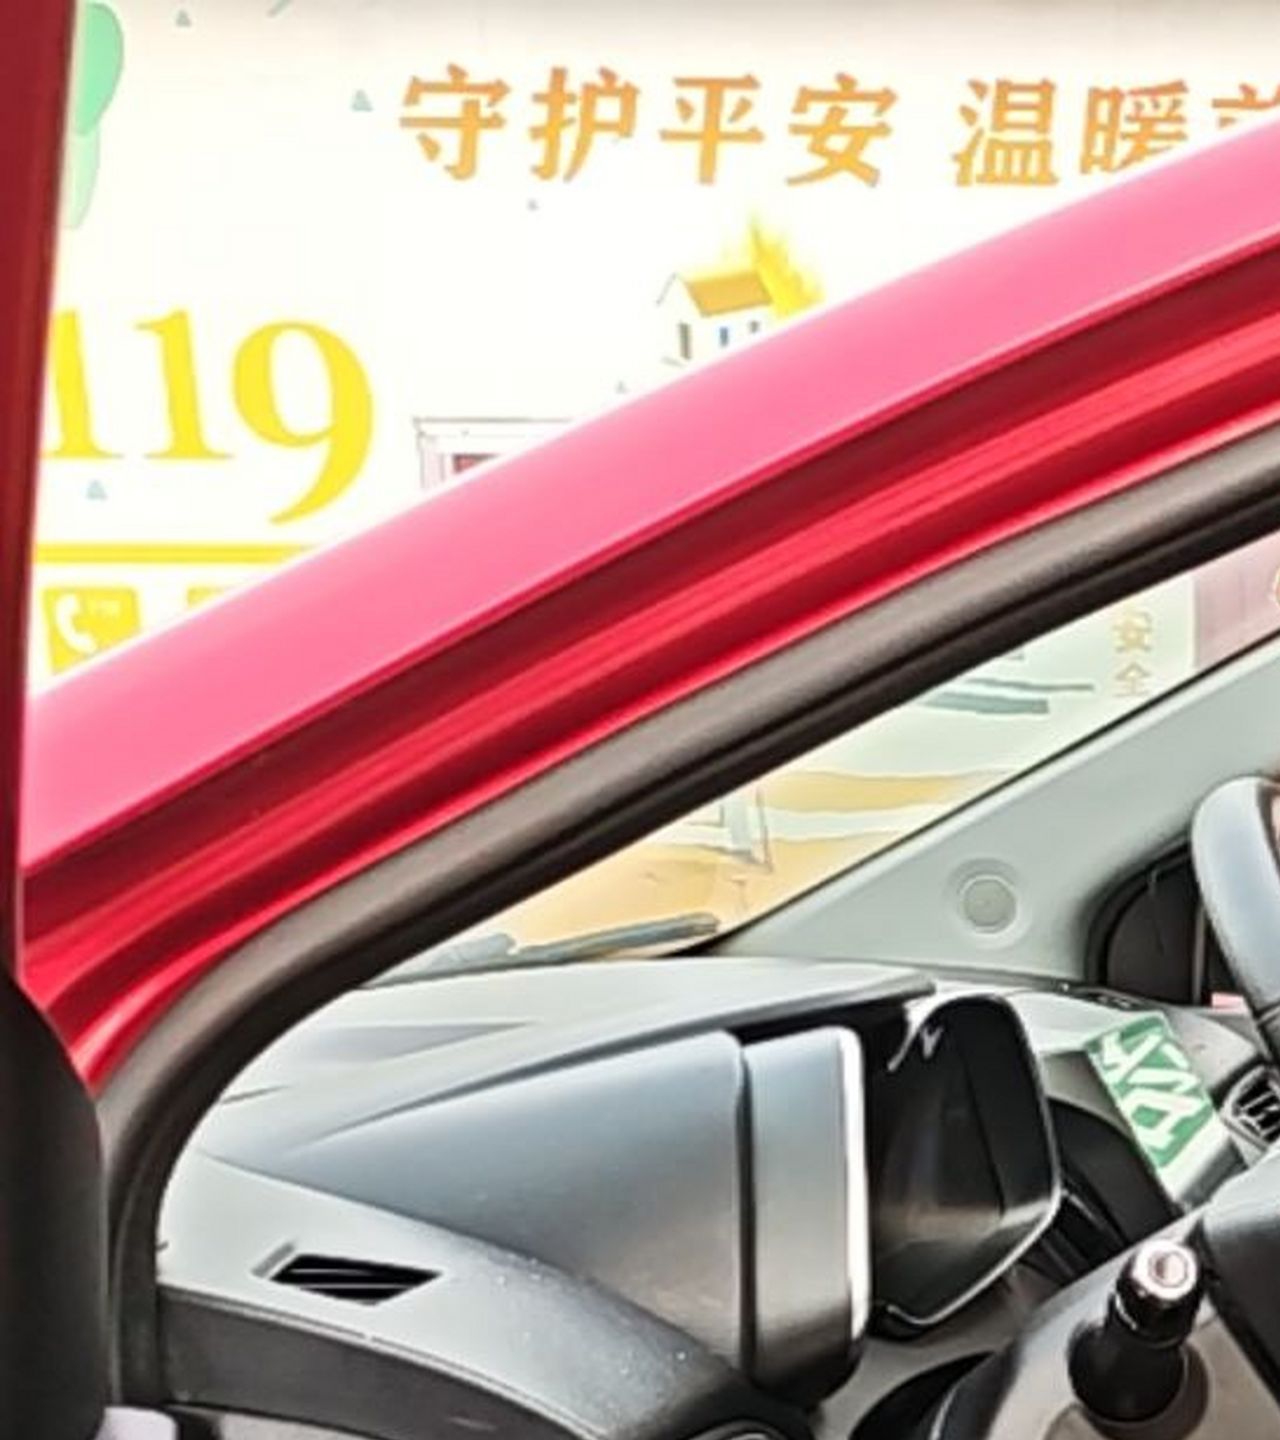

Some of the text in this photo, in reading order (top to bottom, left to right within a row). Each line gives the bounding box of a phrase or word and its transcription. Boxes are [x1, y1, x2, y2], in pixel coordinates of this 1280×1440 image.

[400, 64, 898, 188] 守护平安
[46, 309, 374, 525] 119
